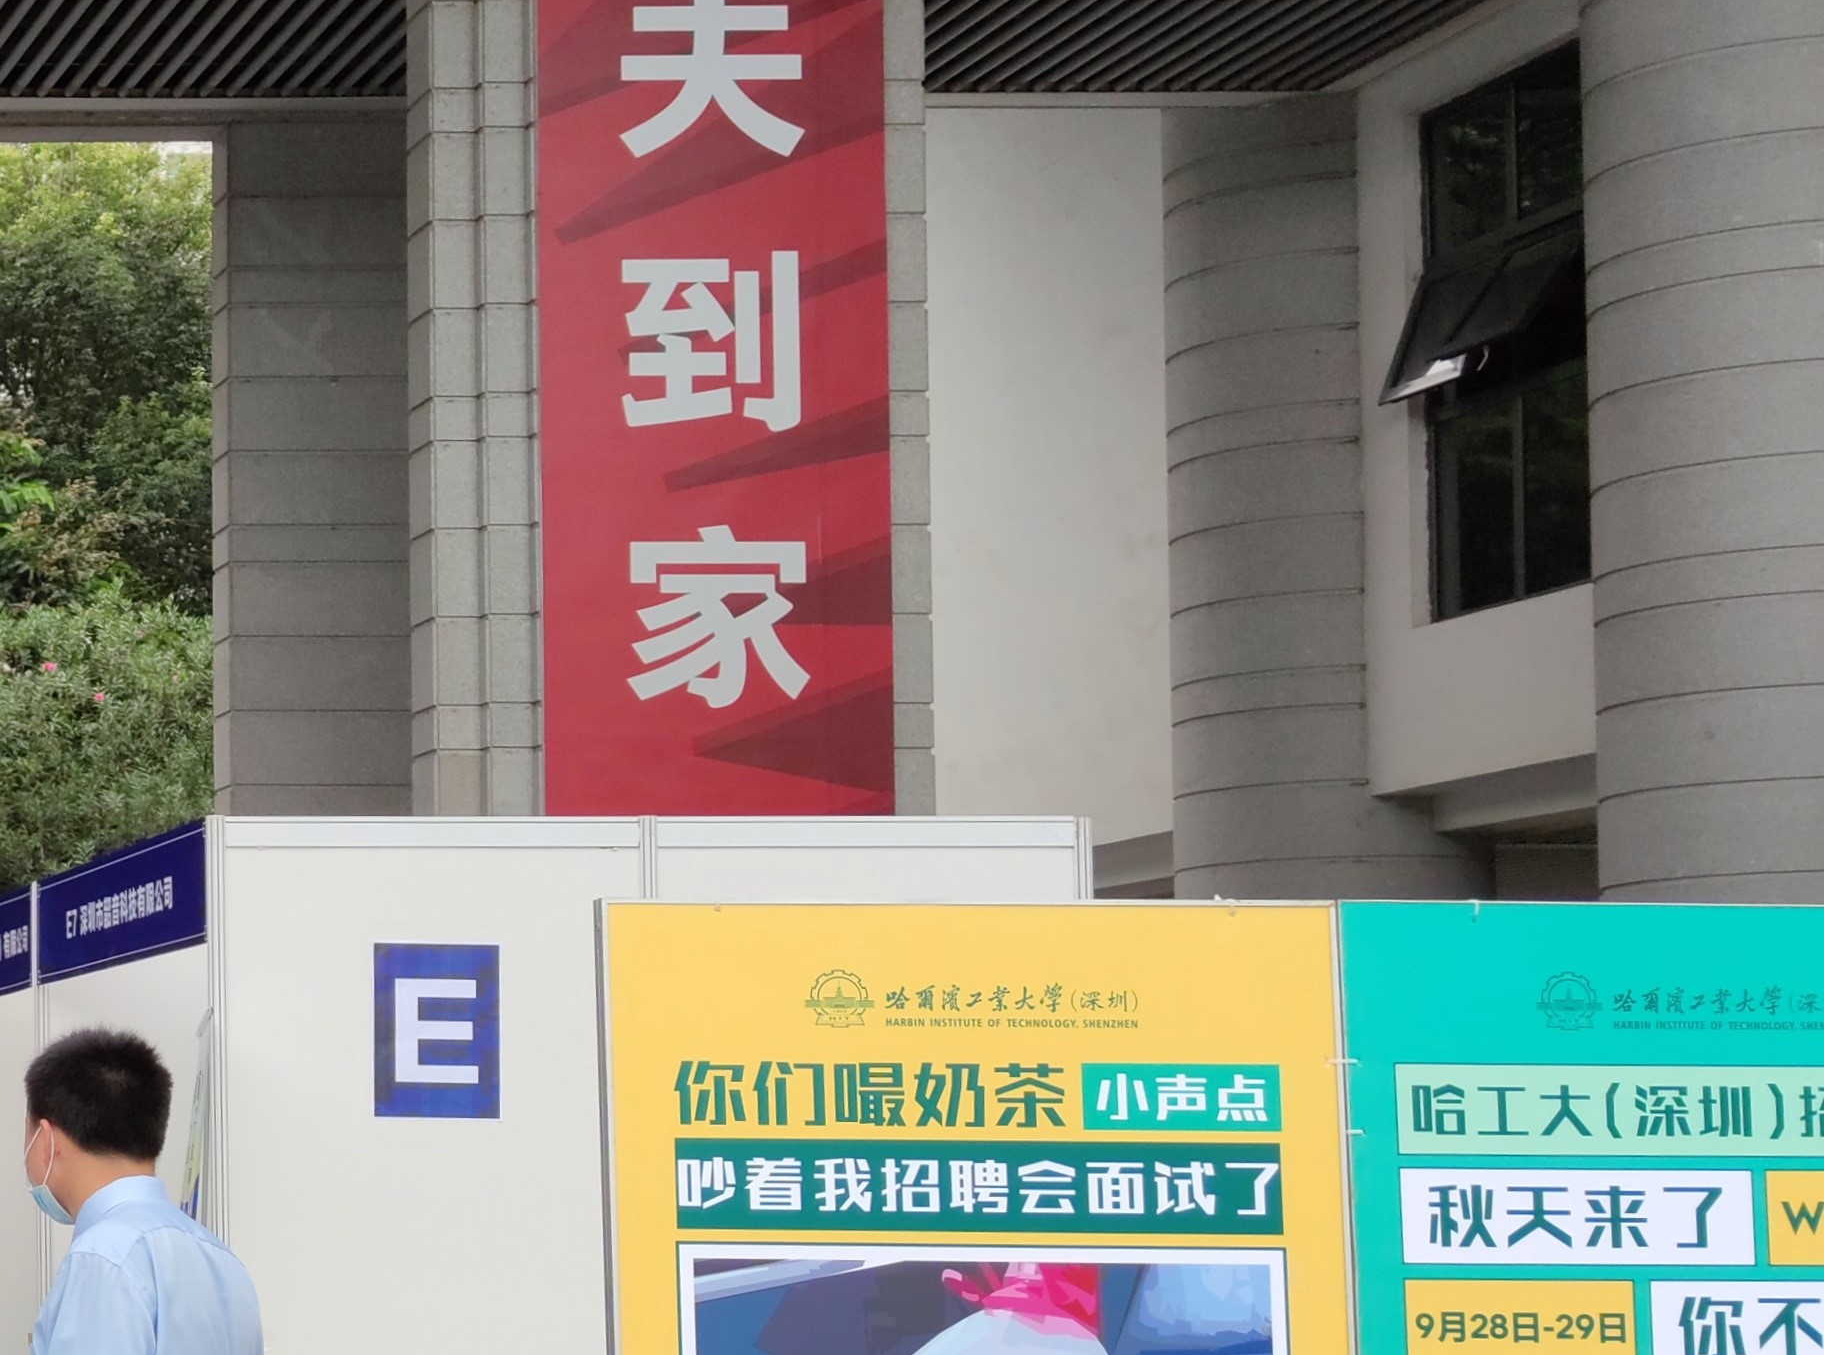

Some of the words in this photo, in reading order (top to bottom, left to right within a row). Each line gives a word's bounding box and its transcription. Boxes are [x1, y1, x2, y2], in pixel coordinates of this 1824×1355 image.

[65, 908, 77, 939] E7
[79, 876, 173, 935] 深圳市韶音科技有限公司
[395, 978, 479, 1084] E
[885, 1017, 925, 1027] HARBIN
[930, 1018, 982, 1027] INSTITUTE
[987, 1018, 1001, 1027] OF
[1083, 1019, 1139, 1028] SHENZHEN
[1613, 1020, 1651, 1030] HARBIN
[1655, 1020, 1706, 1030] INSTITUTE
[1710, 1021, 1723, 1030] OF
[1095, 1072, 1270, 1123] 小声点
[676, 1155, 1280, 1218] 吵着我招聘会面试了
[1427, 1184, 1723, 1249] 秋天来了
[1414, 1311, 1627, 1344] 9月28日-29日
